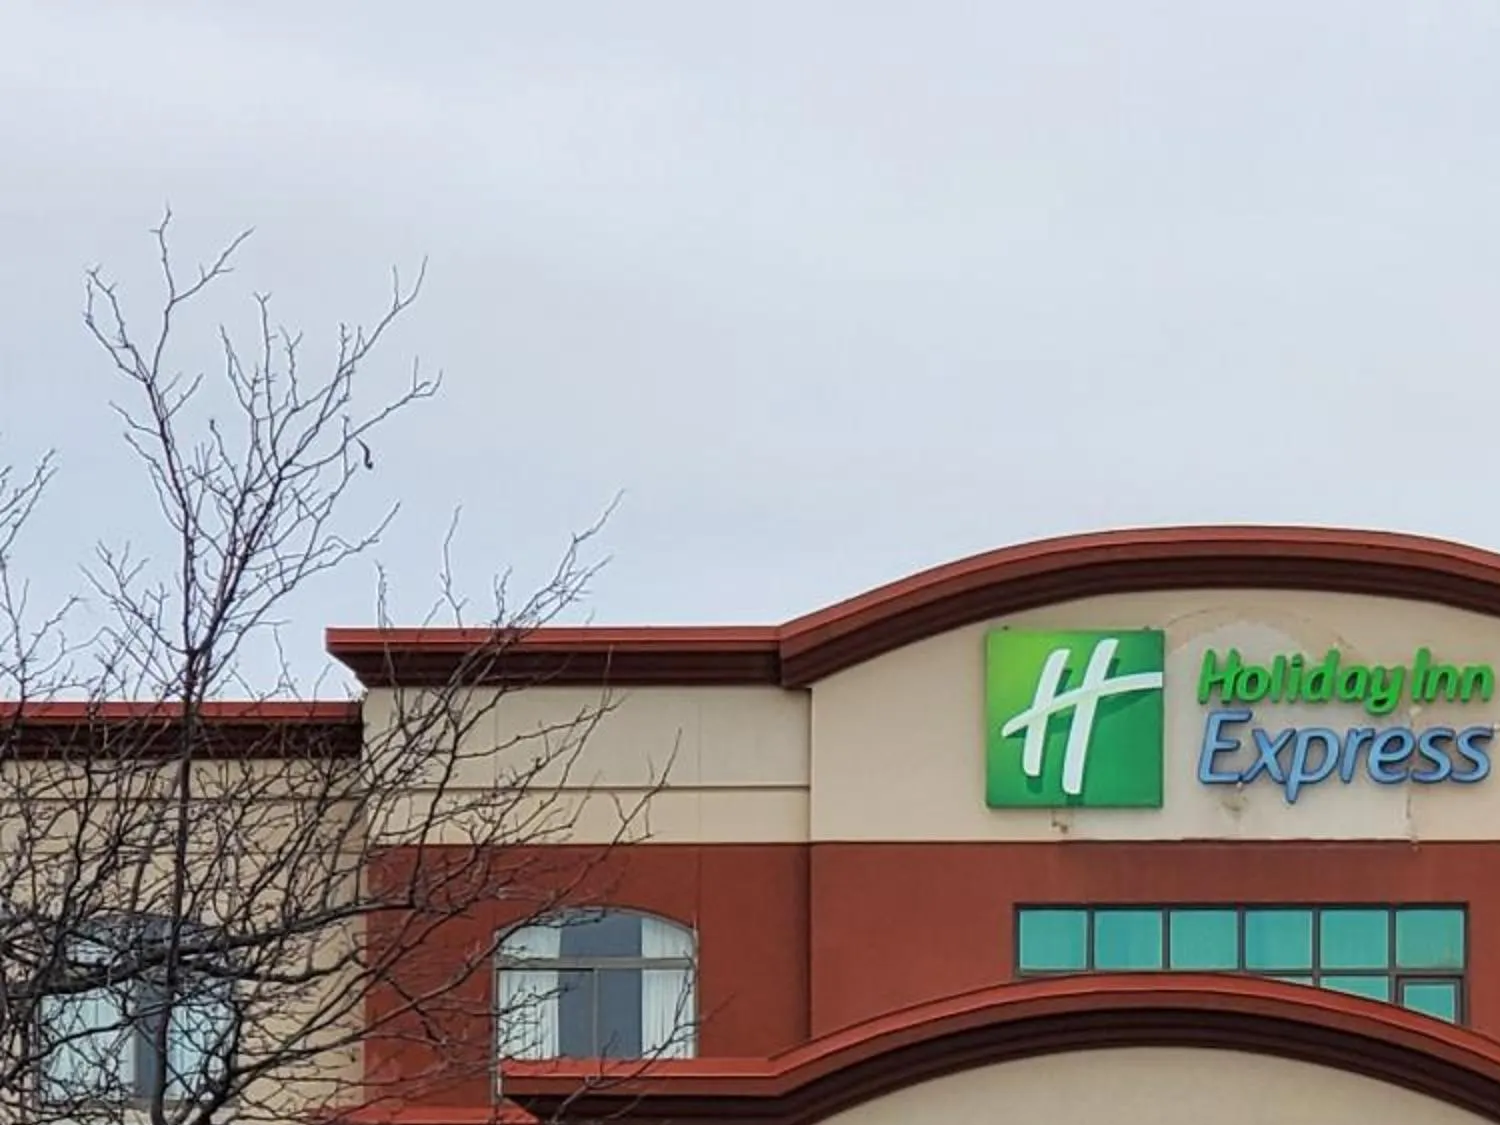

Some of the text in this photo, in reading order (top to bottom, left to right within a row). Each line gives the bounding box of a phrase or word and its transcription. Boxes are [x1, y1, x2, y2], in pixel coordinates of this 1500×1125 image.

[1197, 647, 1495, 716] Holiday Inn
[1197, 709, 1497, 804] Express
